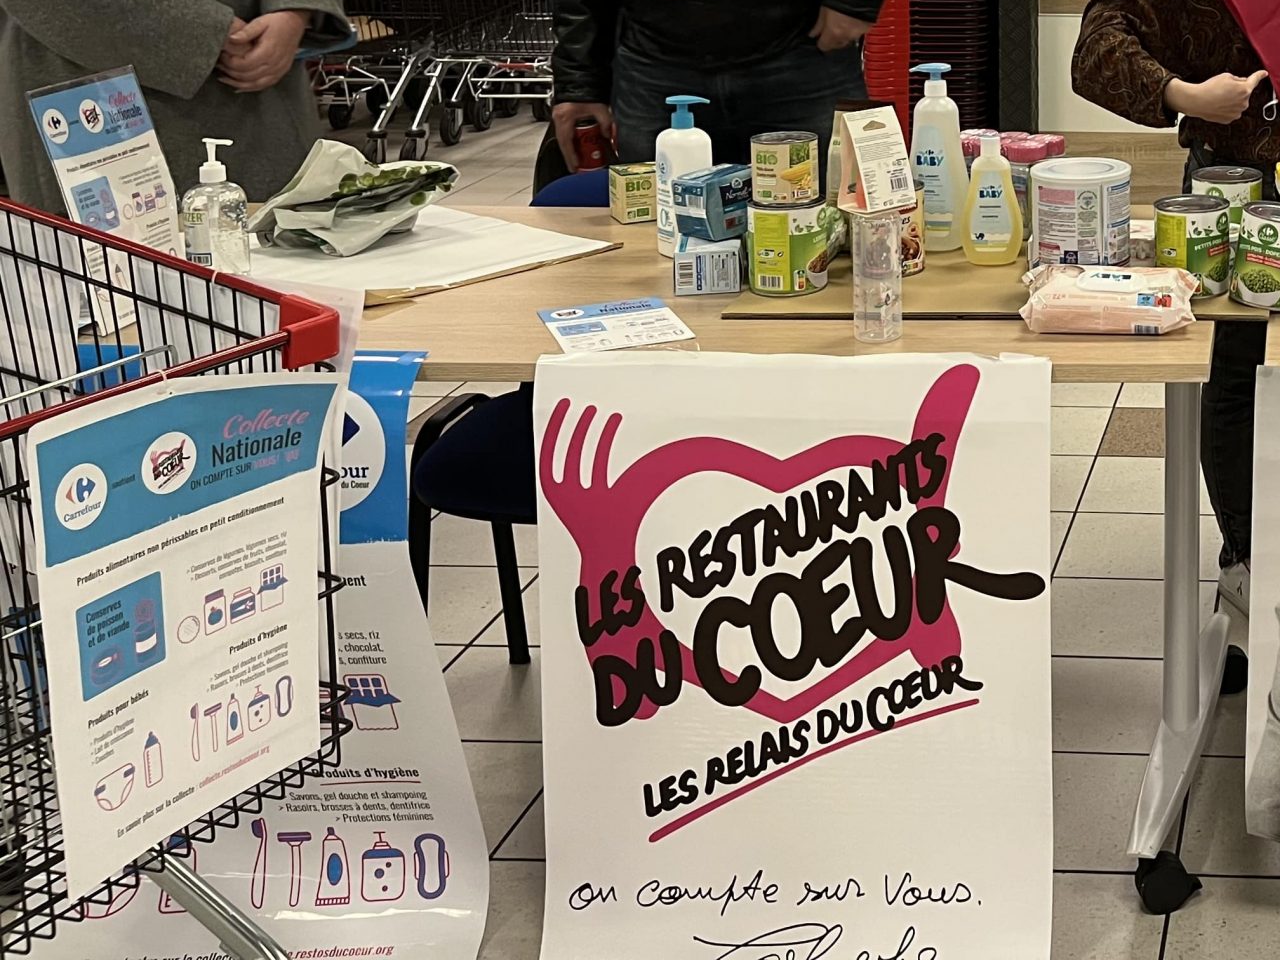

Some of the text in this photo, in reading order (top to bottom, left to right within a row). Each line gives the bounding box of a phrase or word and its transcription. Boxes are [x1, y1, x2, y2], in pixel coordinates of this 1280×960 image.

[756, 154, 777, 164] BIO
[916, 155, 944, 166] BABY
[626, 180, 652, 191] BIO
[979, 190, 1002, 198] BABY
[223, 408, 310, 439] Collecte
[212, 428, 302, 468] Nationale
[63, 501, 101, 522] Carrefour
[77, 497, 284, 586] Produits alimentaires non périssables en petit conditionnement
[574, 433, 947, 648] LES RESTAURANTS
[345, 630, 380, 640] secs, riz
[344, 643, 384, 653] chocolat,
[348, 655, 387, 664] confiture
[591, 630, 682, 727] DU
[643, 769, 698, 818] LES
[705, 720, 811, 796] RELAIS
[816, 699, 863, 746] DU
[290, 792, 322, 801] Savons,
[324, 792, 337, 801] gel
[339, 791, 369, 800] douche
[382, 791, 427, 801] shampoing
[286, 801, 430, 812] Rasoirs, brosses à dents, dentifrice
[343, 812, 434, 823] Protections féminines
[568, 882, 617, 911] on
[637, 869, 778, 916] compte
[797, 878, 866, 906] sur
